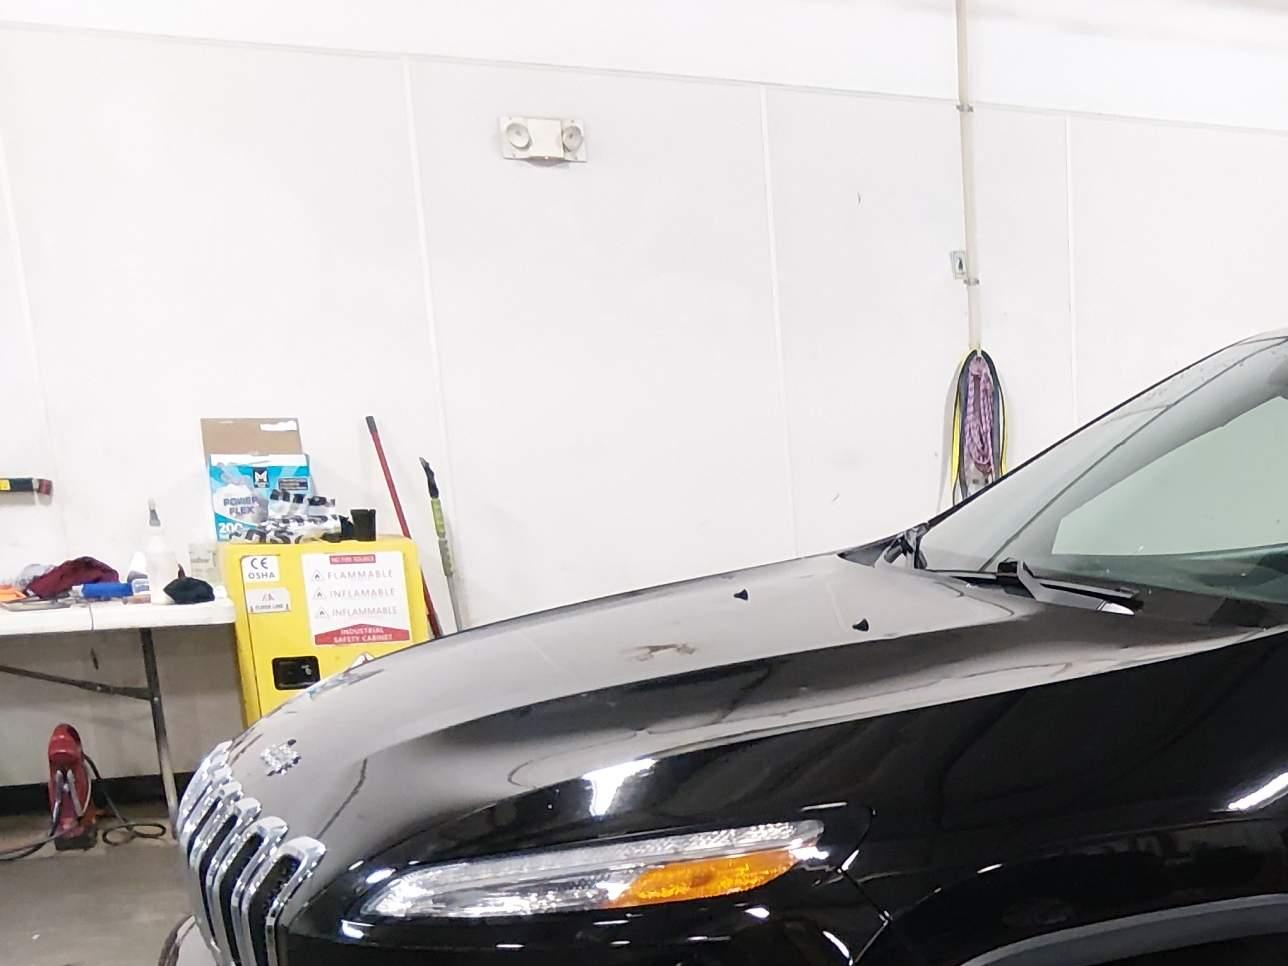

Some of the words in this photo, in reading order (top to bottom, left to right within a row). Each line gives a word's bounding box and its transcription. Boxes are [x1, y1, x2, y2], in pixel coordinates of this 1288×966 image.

[223, 495, 259, 506] POWER
[229, 506, 255, 515] FLEX
[247, 571, 276, 580] OSHA
[327, 568, 393, 580] FLAMMABLE
[332, 606, 398, 618] INFLAMMABLE
